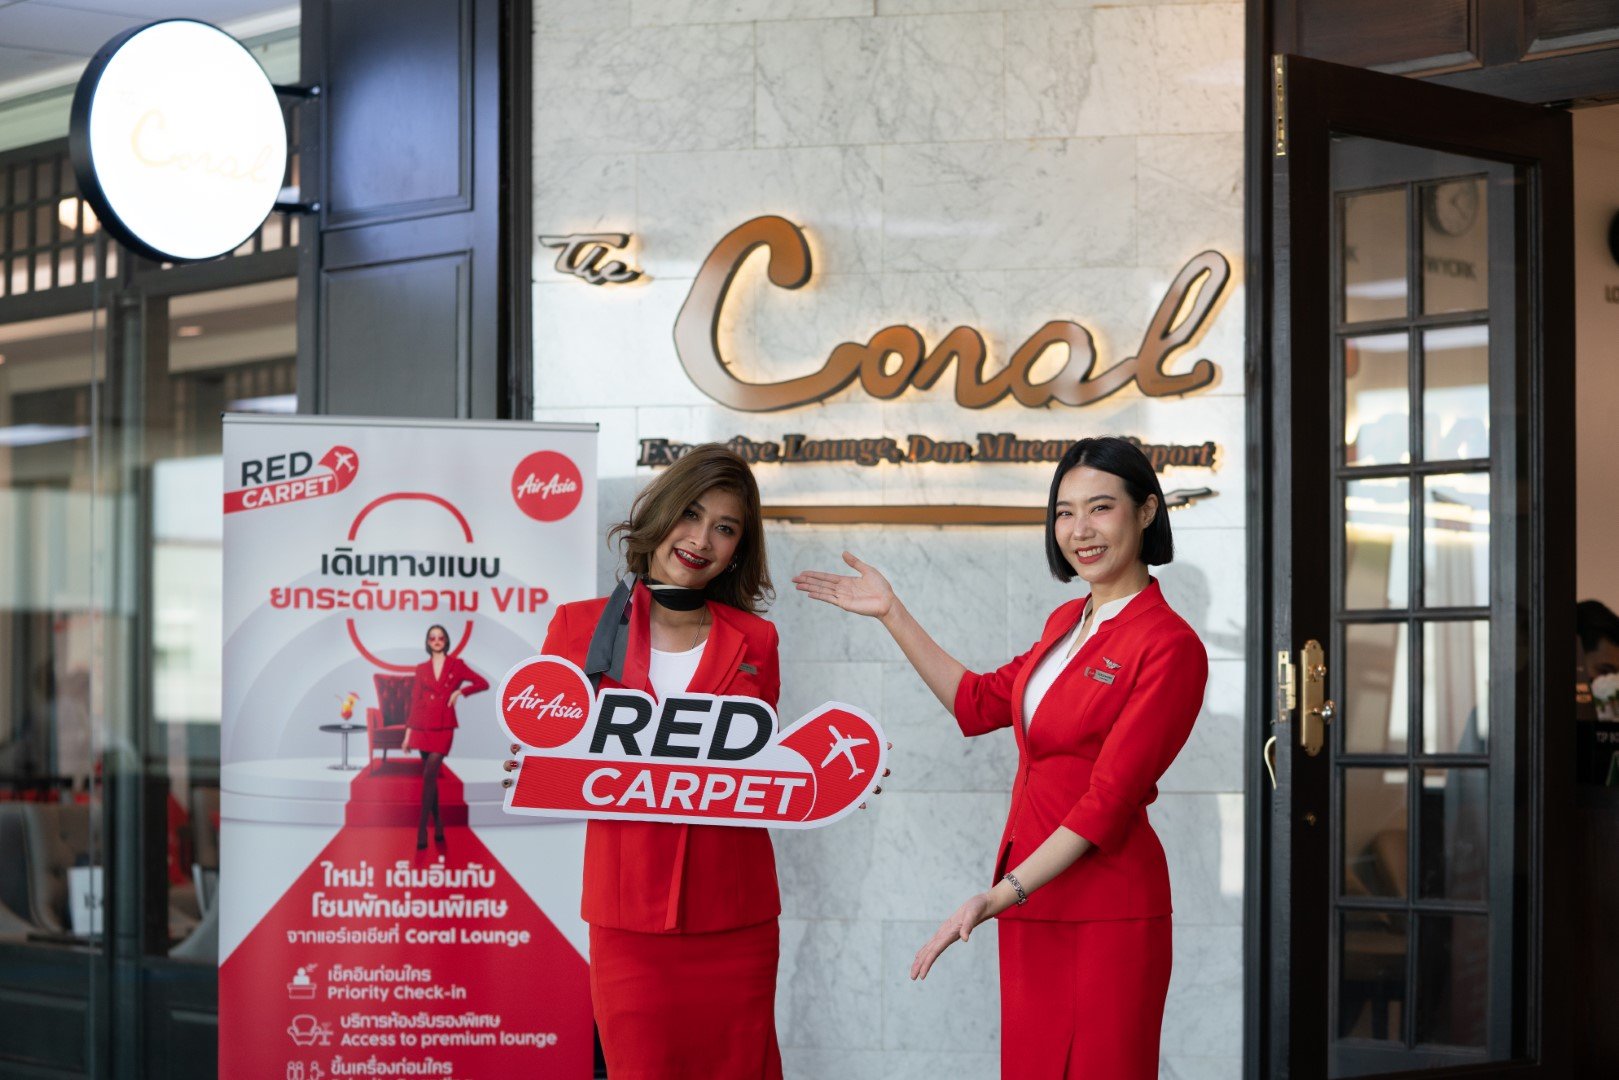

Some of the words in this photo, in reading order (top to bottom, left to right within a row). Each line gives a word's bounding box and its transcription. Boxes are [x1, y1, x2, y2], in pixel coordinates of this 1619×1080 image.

[538, 233, 641, 286] The
[673, 215, 1231, 412] Coral
[907, 434, 972, 463] Don
[241, 451, 313, 487] RED
[241, 474, 334, 510] CARPET
[321, 547, 501, 578] เดินทางแบบ
[269, 580, 480, 613] ยกระดับความ
[491, 586, 549, 613] VIP
[588, 694, 773, 761] RED
[581, 767, 807, 815] CARPET
[320, 860, 374, 888] ใหม่!
[386, 855, 496, 888] เต็มอิ่มกับ
[312, 892, 508, 918] โซนพักผ่อนพิเศษ
[405, 928, 456, 944] Coral
[461, 928, 531, 947] Lounge
[328, 985, 389, 1002] Priority
[394, 985, 467, 1000] Check-in
[341, 1032, 396, 1046] Access
[400, 1032, 417, 1046] to
[421, 1032, 496, 1049] premium
[500, 1031, 557, 1048] lounge
